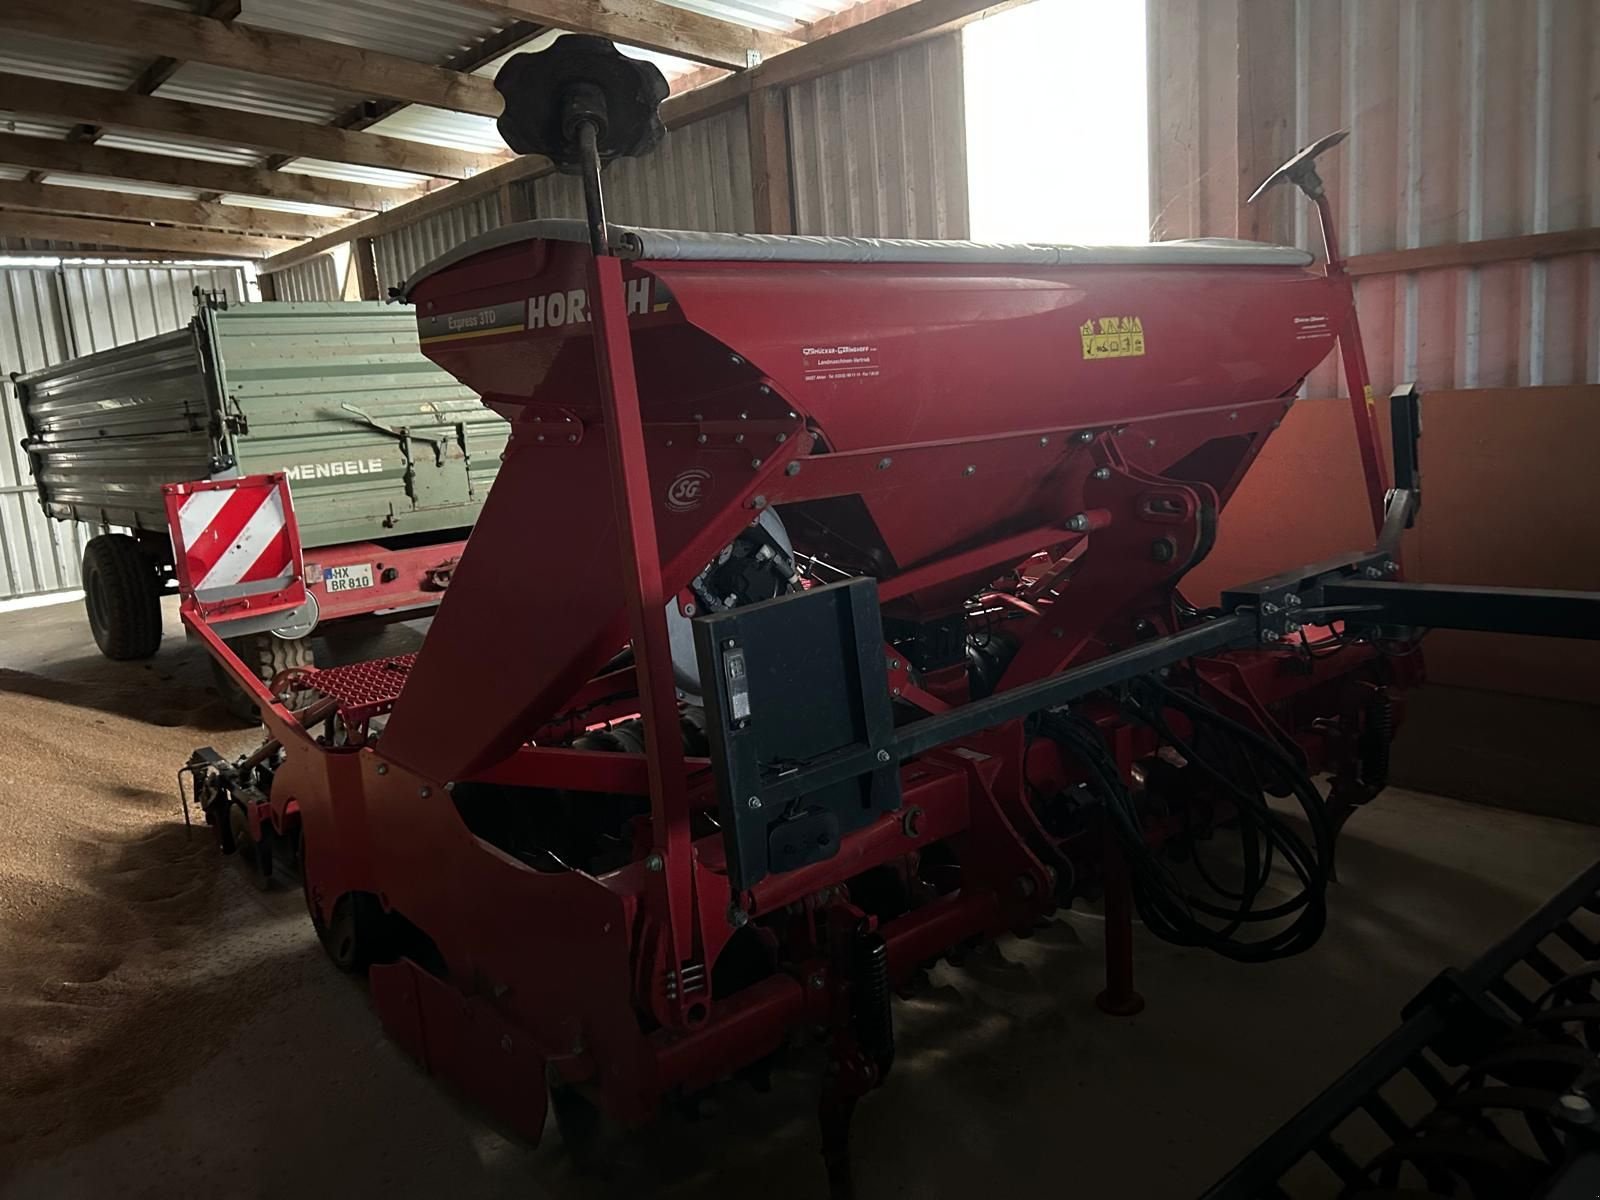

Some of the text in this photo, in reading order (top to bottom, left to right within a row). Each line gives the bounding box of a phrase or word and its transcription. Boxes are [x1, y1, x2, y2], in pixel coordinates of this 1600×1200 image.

[528, 276, 650, 330] HORH
[448, 316, 478, 330] Express
[283, 458, 383, 480] MENGELE
[334, 567, 349, 579] HX
[331, 576, 369, 591] BR 810
